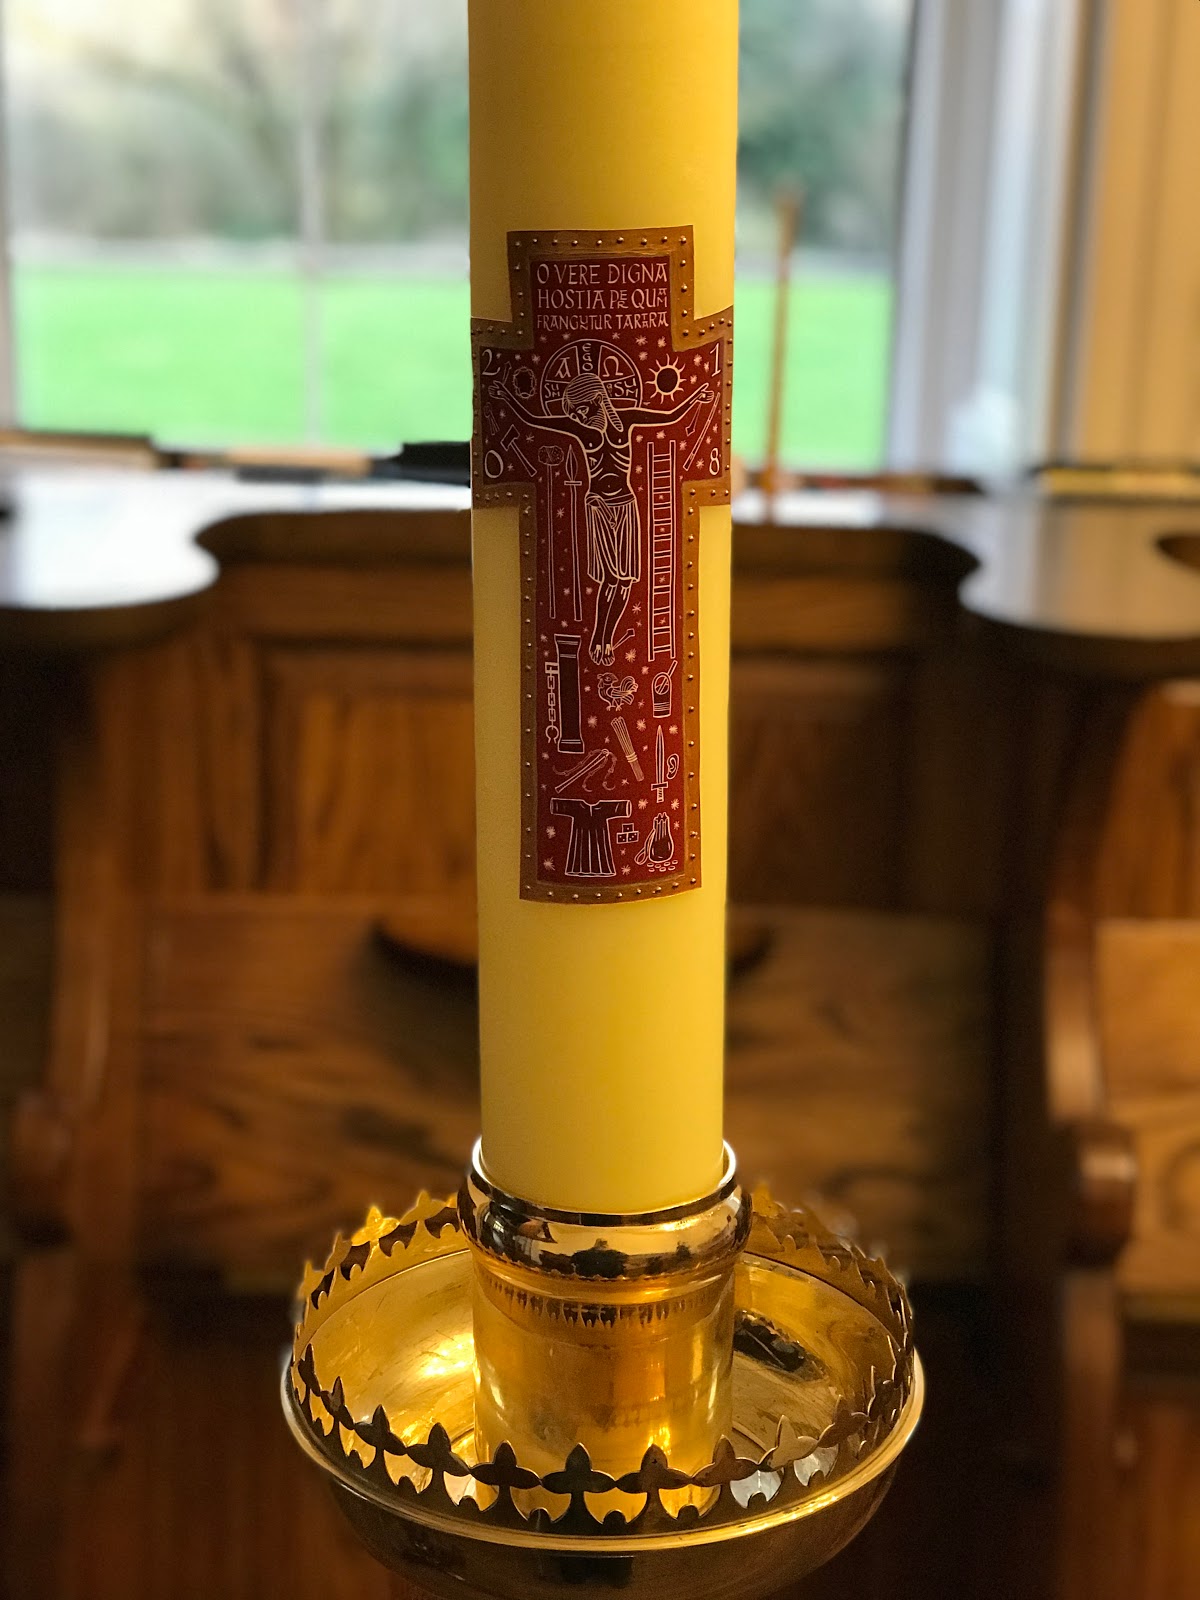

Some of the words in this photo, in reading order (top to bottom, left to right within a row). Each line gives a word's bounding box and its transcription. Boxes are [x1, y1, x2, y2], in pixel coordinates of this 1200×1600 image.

[537, 263, 550, 284] O
[553, 263, 601, 285] VERE
[607, 262, 668, 284] DIGNA
[537, 288, 606, 309] HOSTIA
[481, 348, 501, 376] 2
[709, 343, 721, 377] 1
[709, 447, 721, 476] 8
